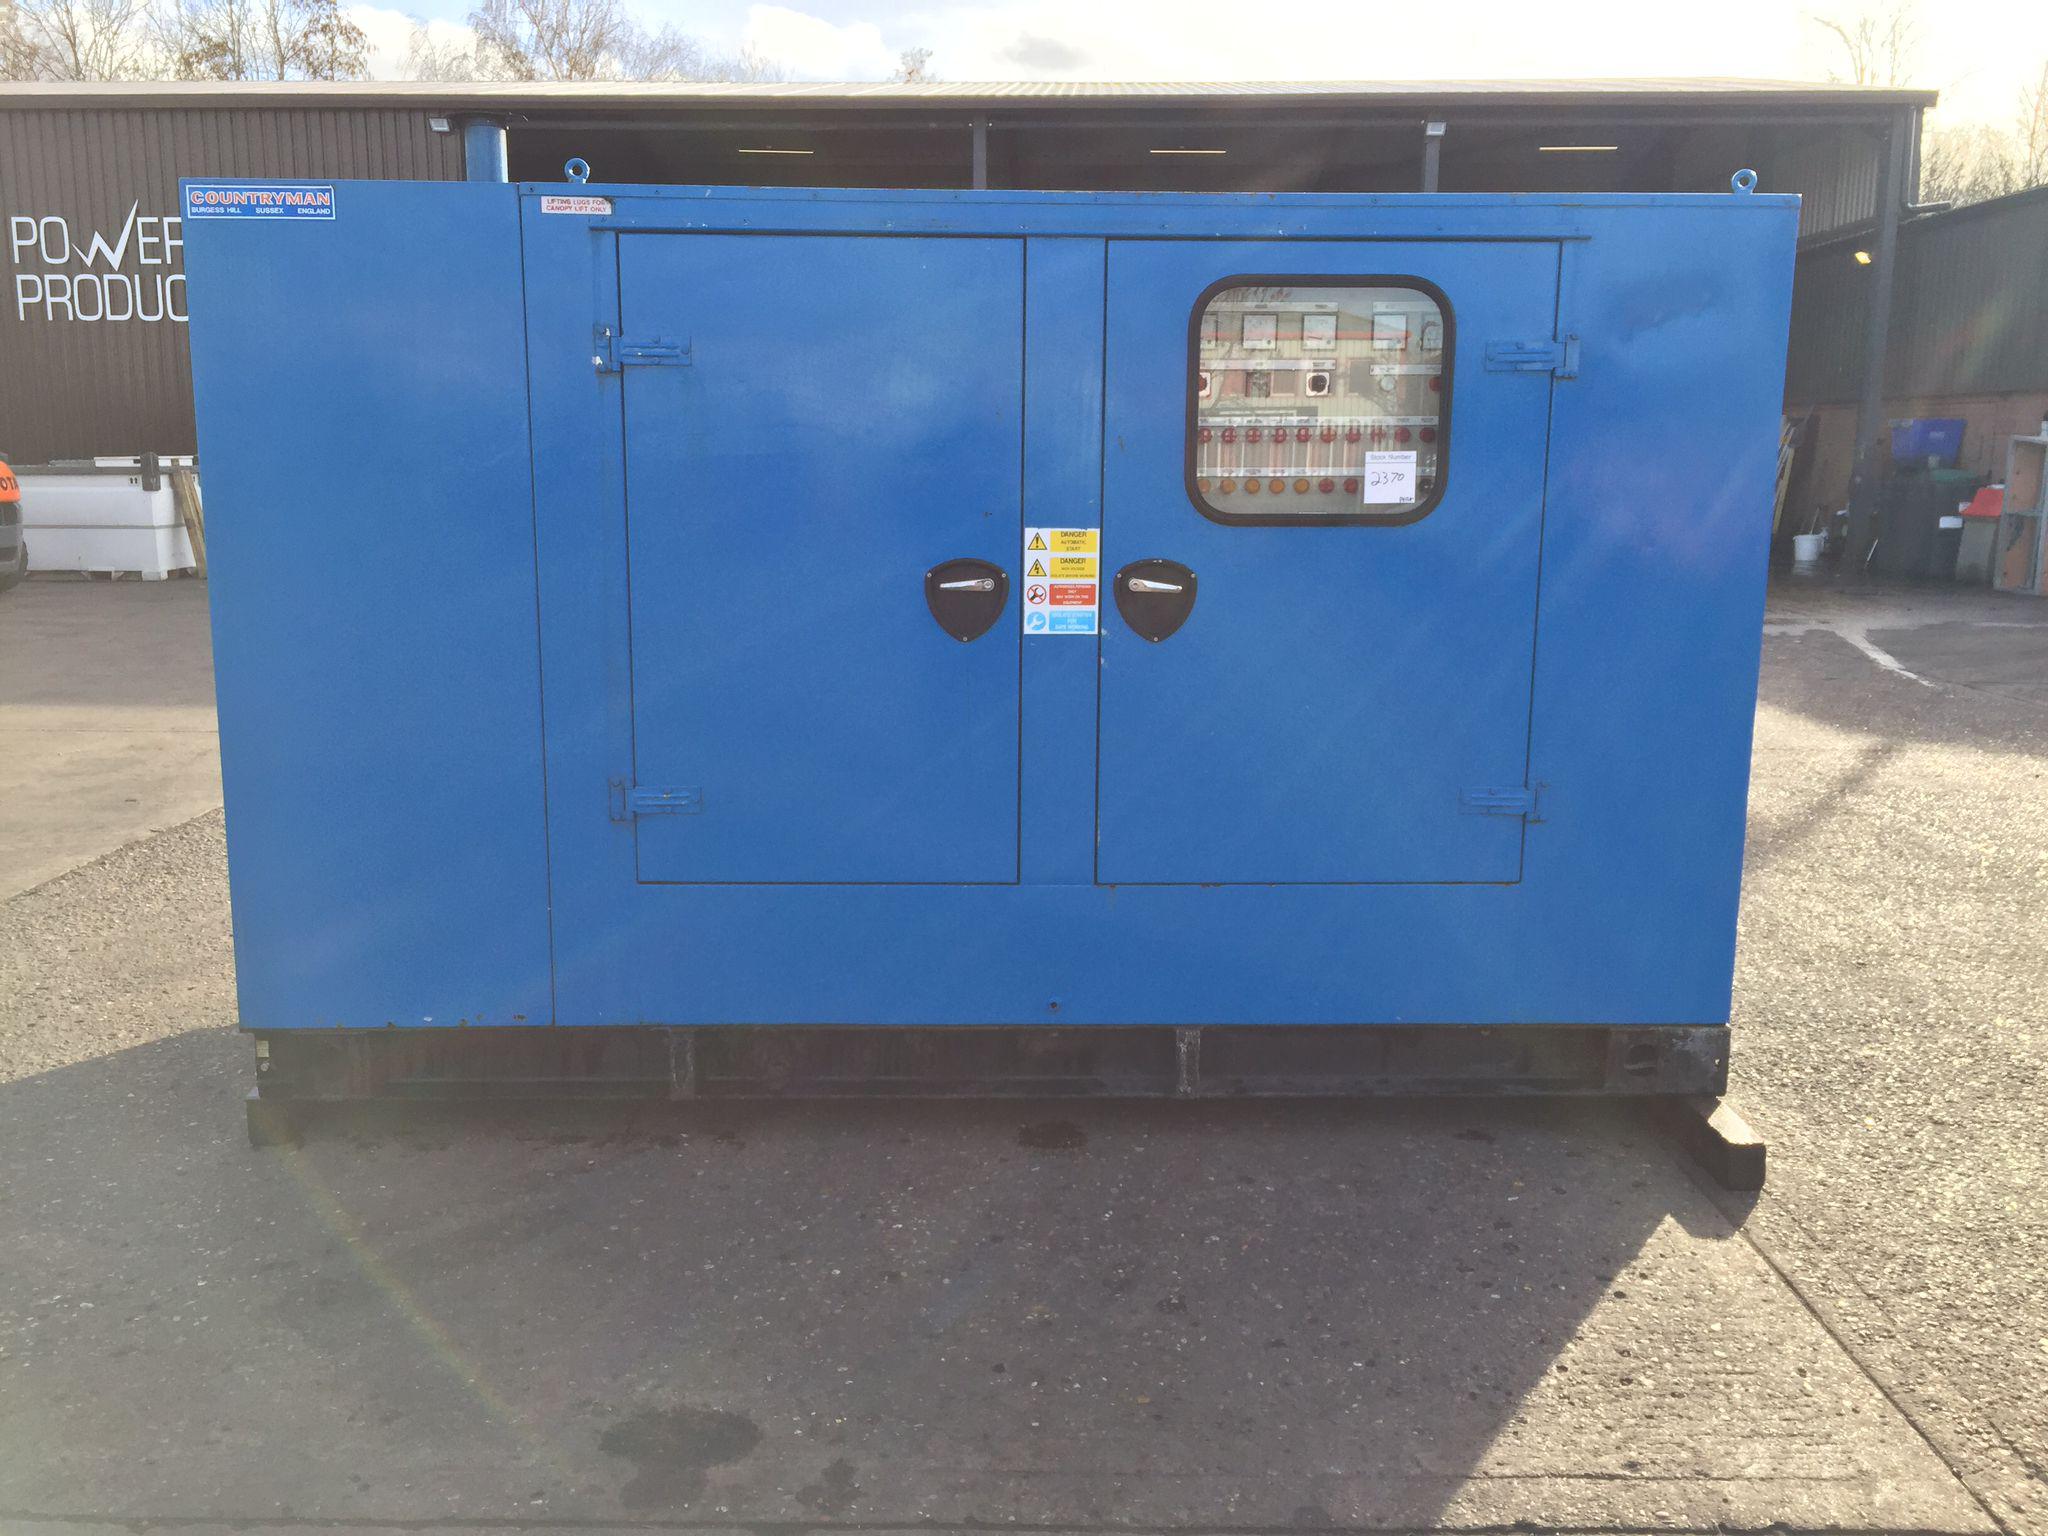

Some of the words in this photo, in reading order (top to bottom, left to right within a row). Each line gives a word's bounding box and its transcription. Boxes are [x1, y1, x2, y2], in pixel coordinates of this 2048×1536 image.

[190, 191, 331, 206] COUNTRYMAN
[191, 206, 225, 214] BURGESS
[255, 207, 284, 215] SUSSEX
[1371, 471, 1405, 487] 2370
